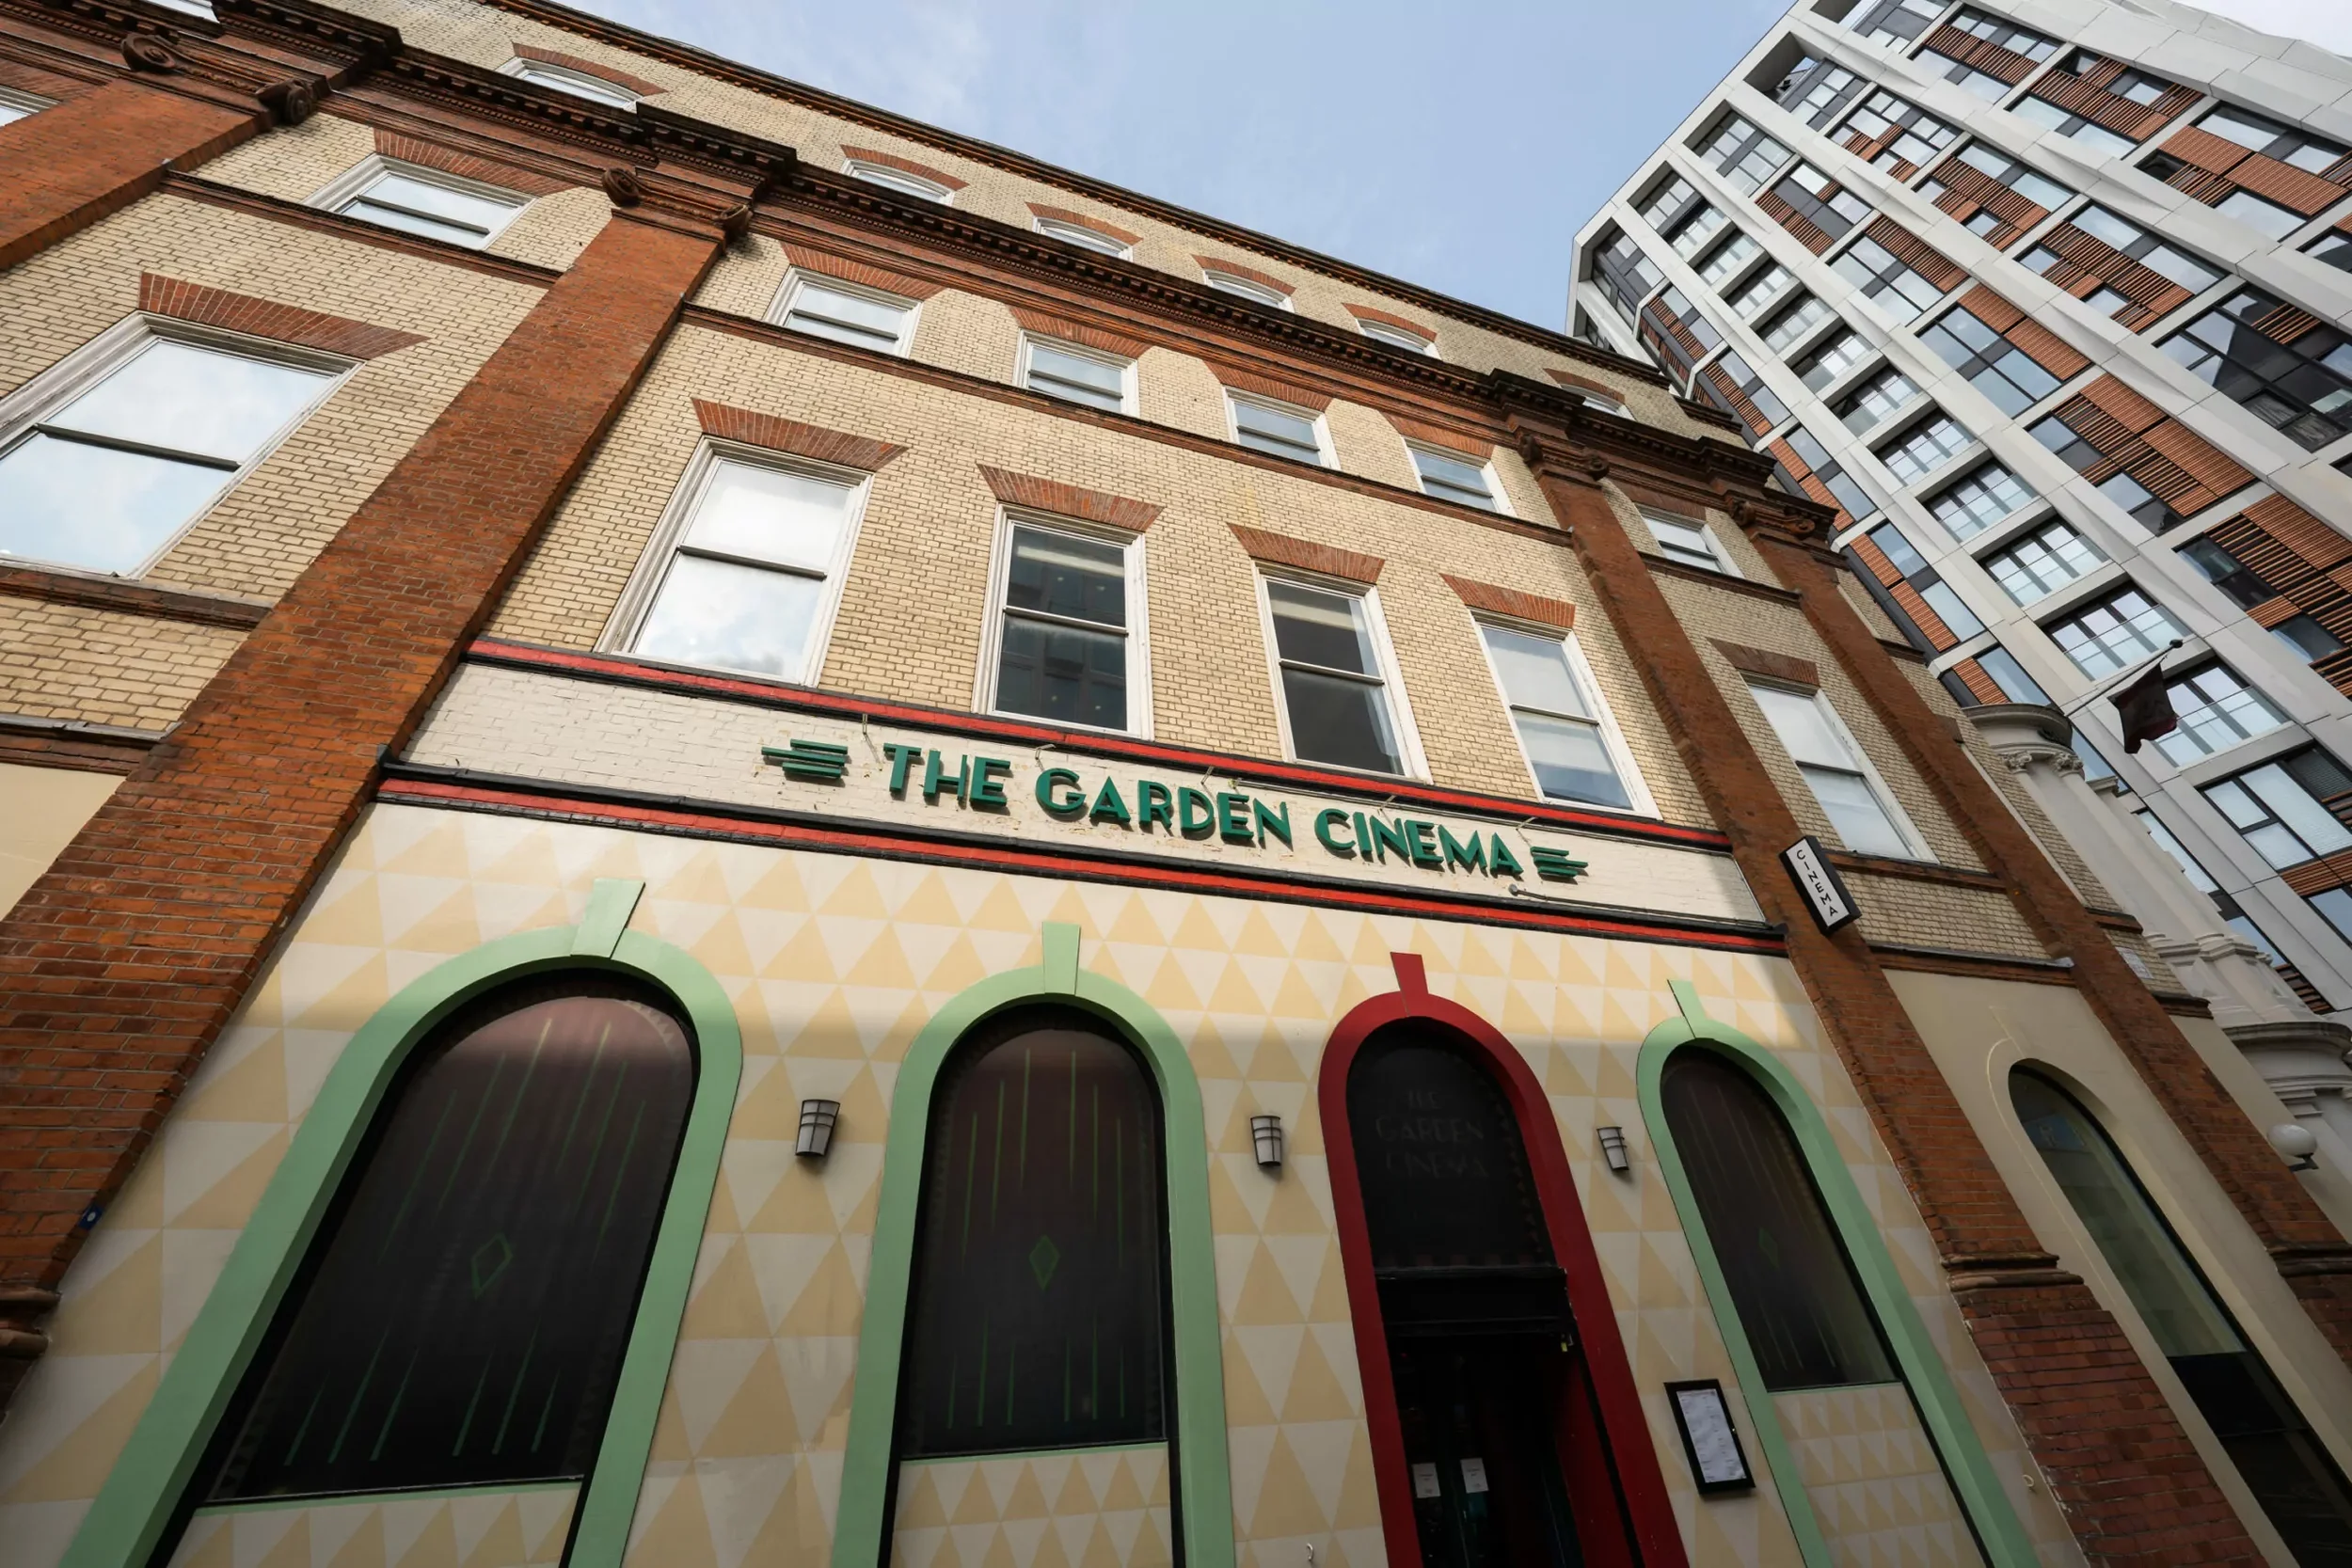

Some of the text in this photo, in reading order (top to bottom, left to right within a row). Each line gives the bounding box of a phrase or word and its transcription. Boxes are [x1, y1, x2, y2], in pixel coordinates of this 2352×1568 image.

[883, 742, 1523, 877] THE GARDEN CINEMA
[1796, 849, 1838, 917] CINEMA
